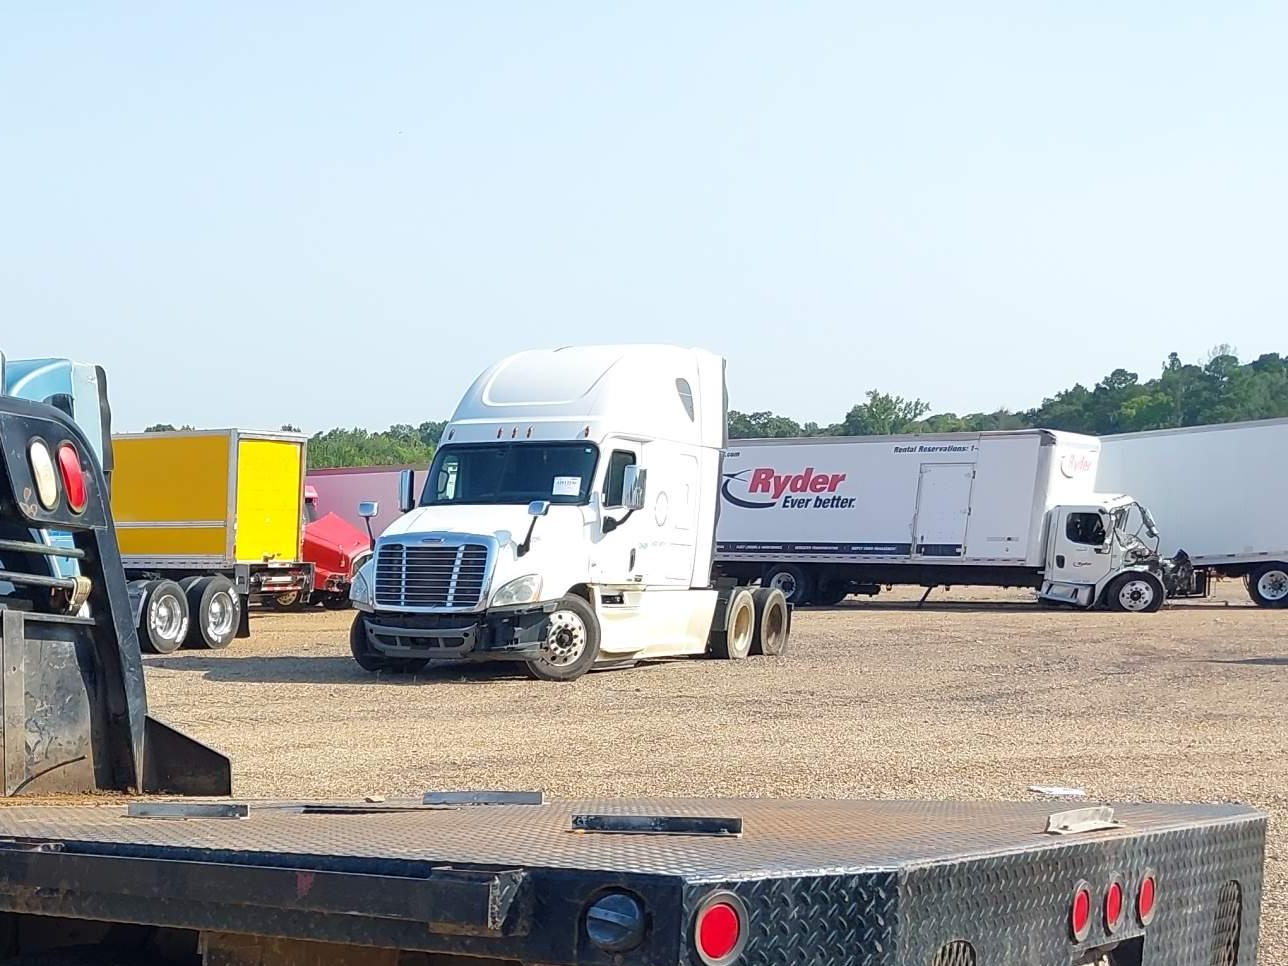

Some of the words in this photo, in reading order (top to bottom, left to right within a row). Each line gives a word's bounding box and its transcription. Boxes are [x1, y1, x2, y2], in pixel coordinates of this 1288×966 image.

[749, 467, 846, 499] Ryder
[782, 496, 812, 508] Ever
[813, 496, 856, 508] better.
